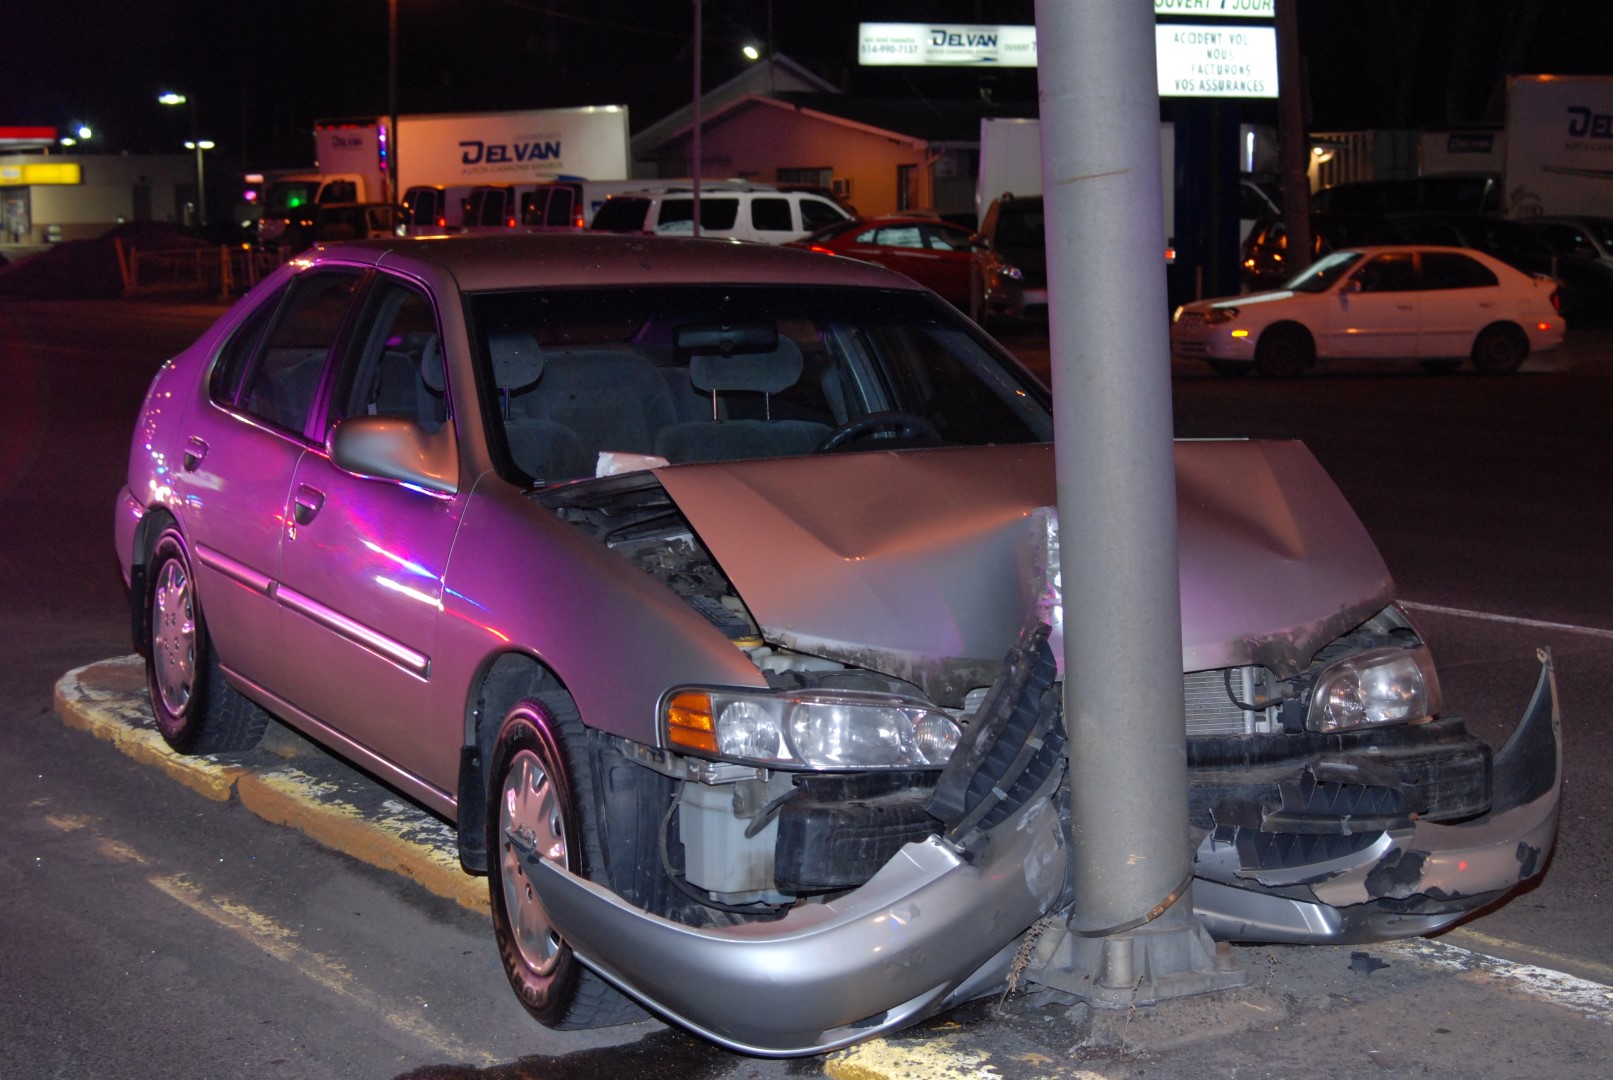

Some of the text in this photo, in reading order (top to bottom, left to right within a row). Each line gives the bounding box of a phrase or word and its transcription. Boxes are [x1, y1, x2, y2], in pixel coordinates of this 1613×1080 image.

[930, 29, 998, 48] DELVAN
[1173, 32, 1248, 46] ACCIDENT VOL
[1003, 43, 1030, 52] OUVERT
[1206, 48, 1234, 60] NOUS
[1191, 63, 1251, 76] FACTURONS
[1174, 79, 1265, 92] VOS ASSURANCES
[459, 140, 561, 165] DELVAN
